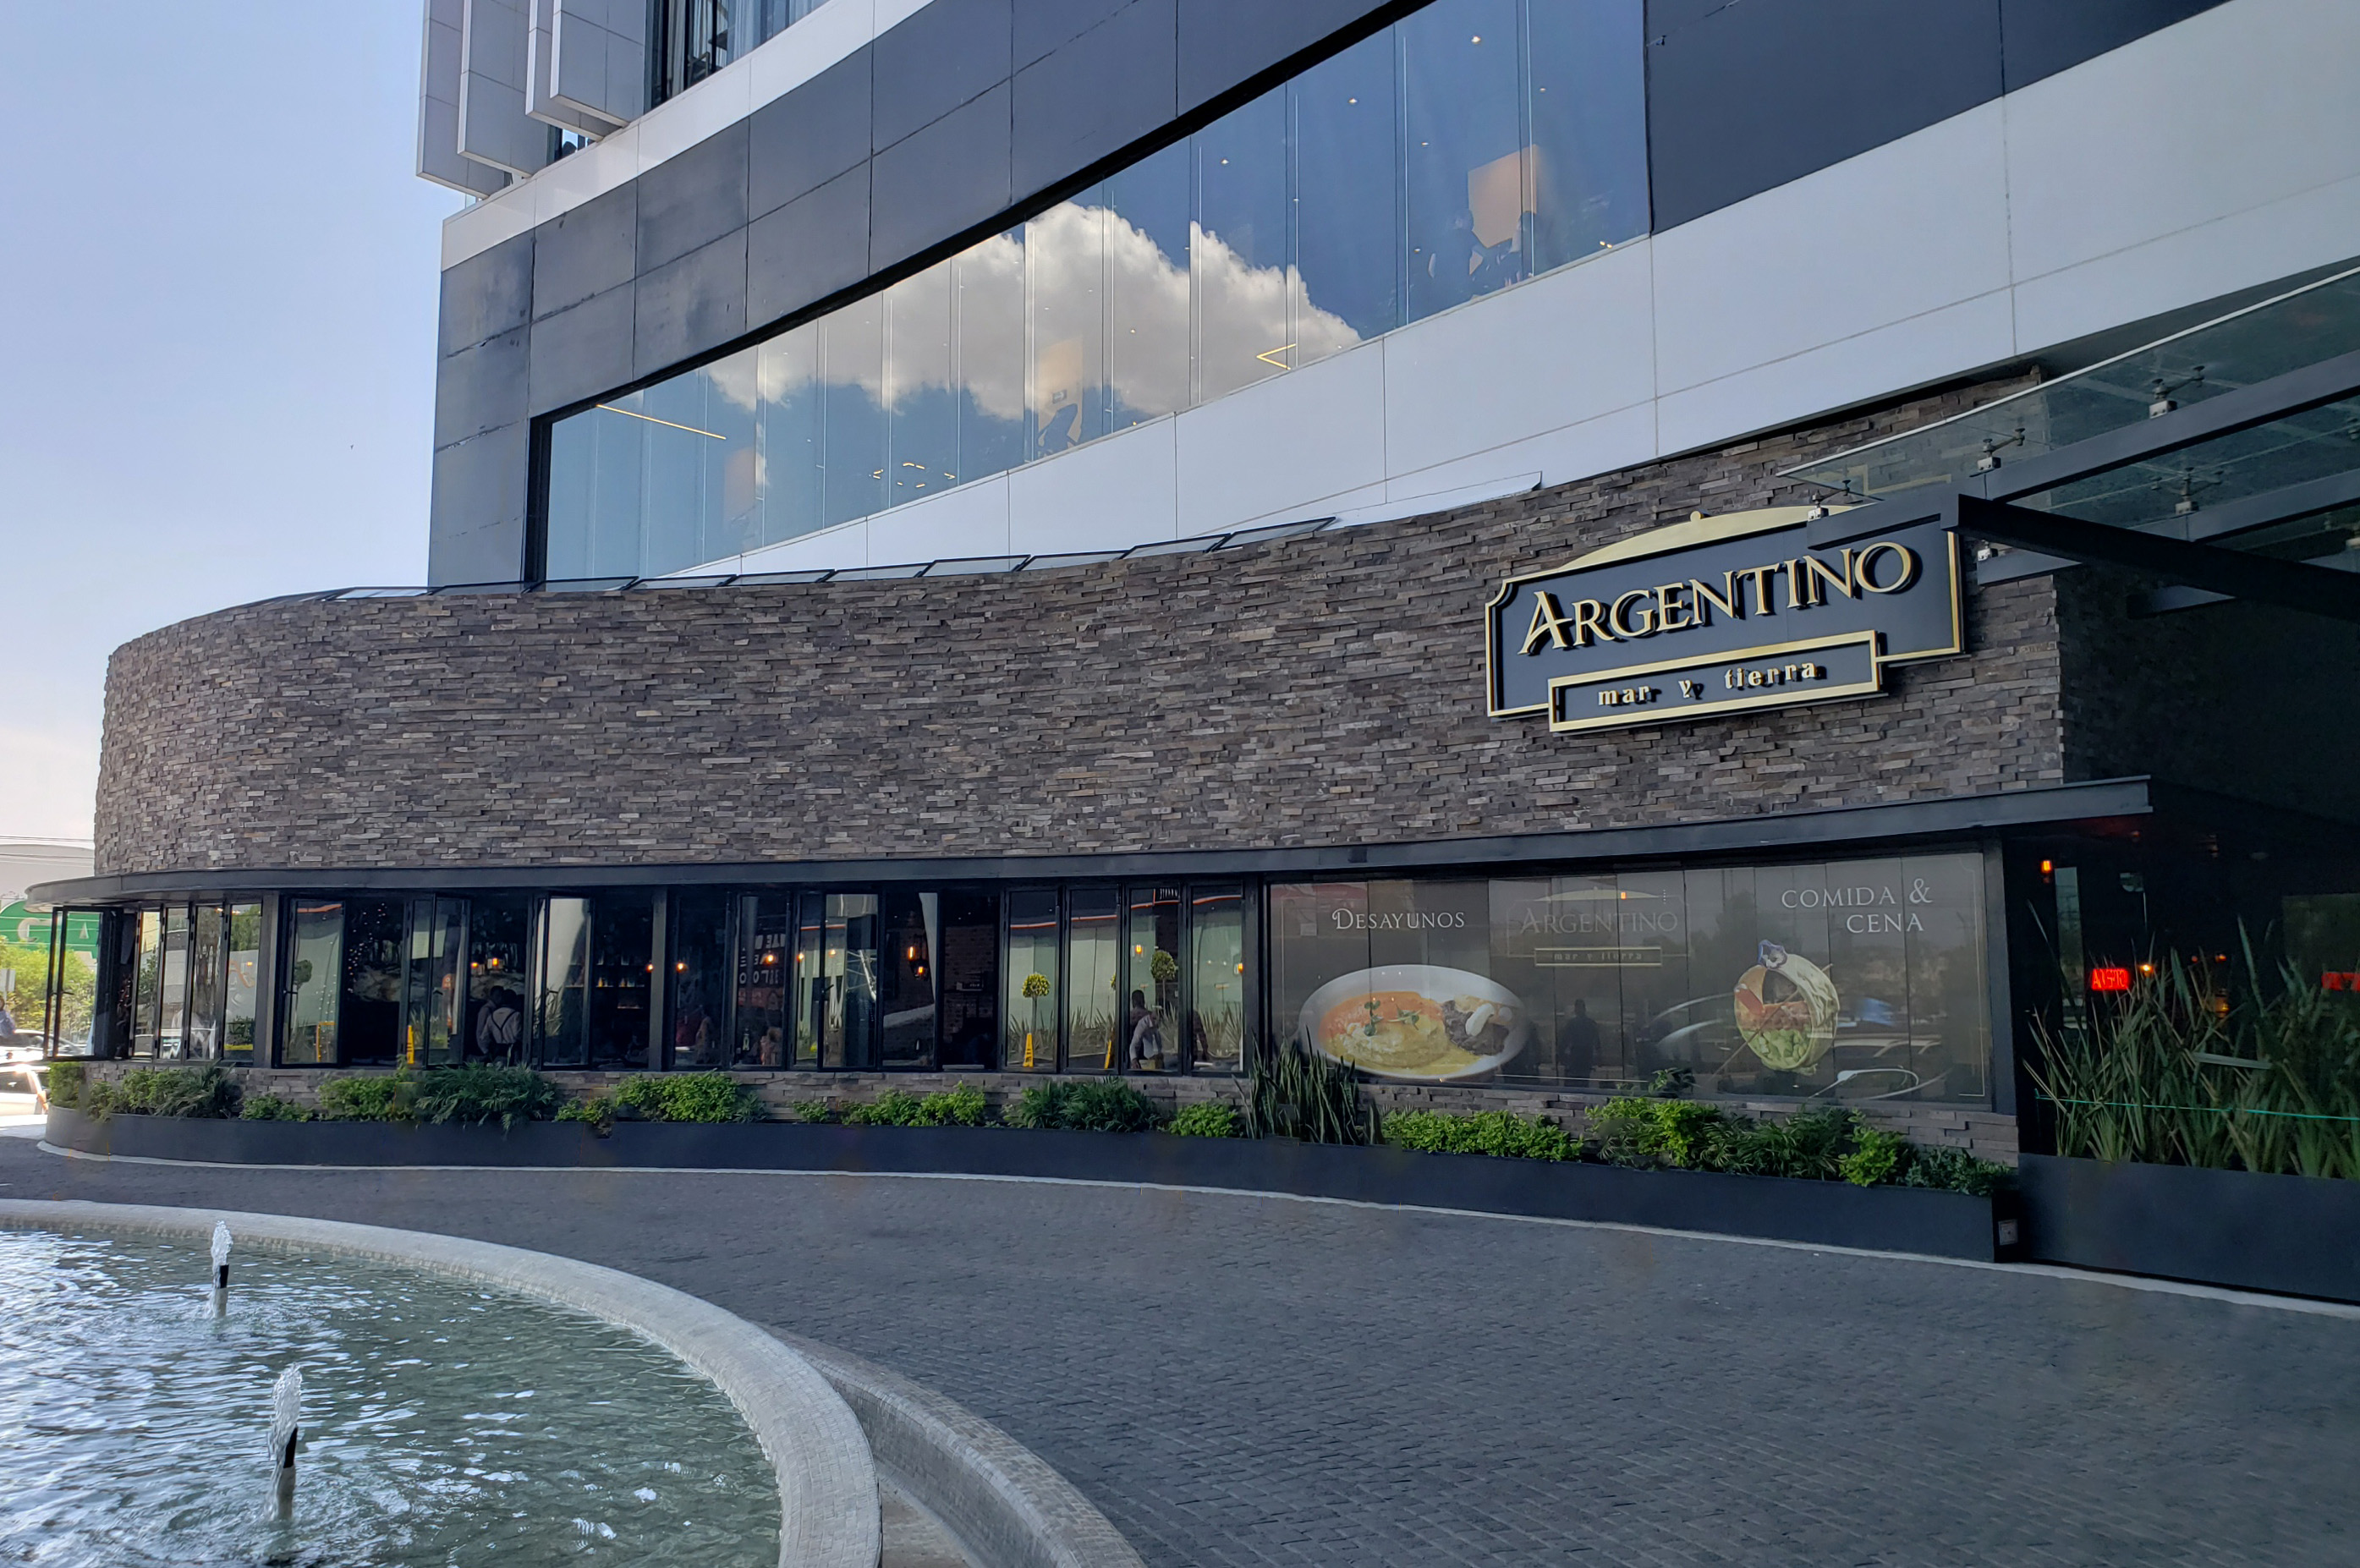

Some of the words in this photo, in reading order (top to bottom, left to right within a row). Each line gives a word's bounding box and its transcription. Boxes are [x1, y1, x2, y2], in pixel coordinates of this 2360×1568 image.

[1518, 541, 1913, 655] ARGENTINO
[1598, 685, 1650, 705] mar
[1678, 679, 1692, 699] y
[1725, 662, 1816, 689] tierra
[1781, 886, 1896, 908] COMIDA
[1908, 878, 1934, 904] &
[1331, 907, 1465, 929] DESAYUNOS
[1520, 907, 1678, 934] ARGENTINO
[1846, 913, 1924, 934] CENA
